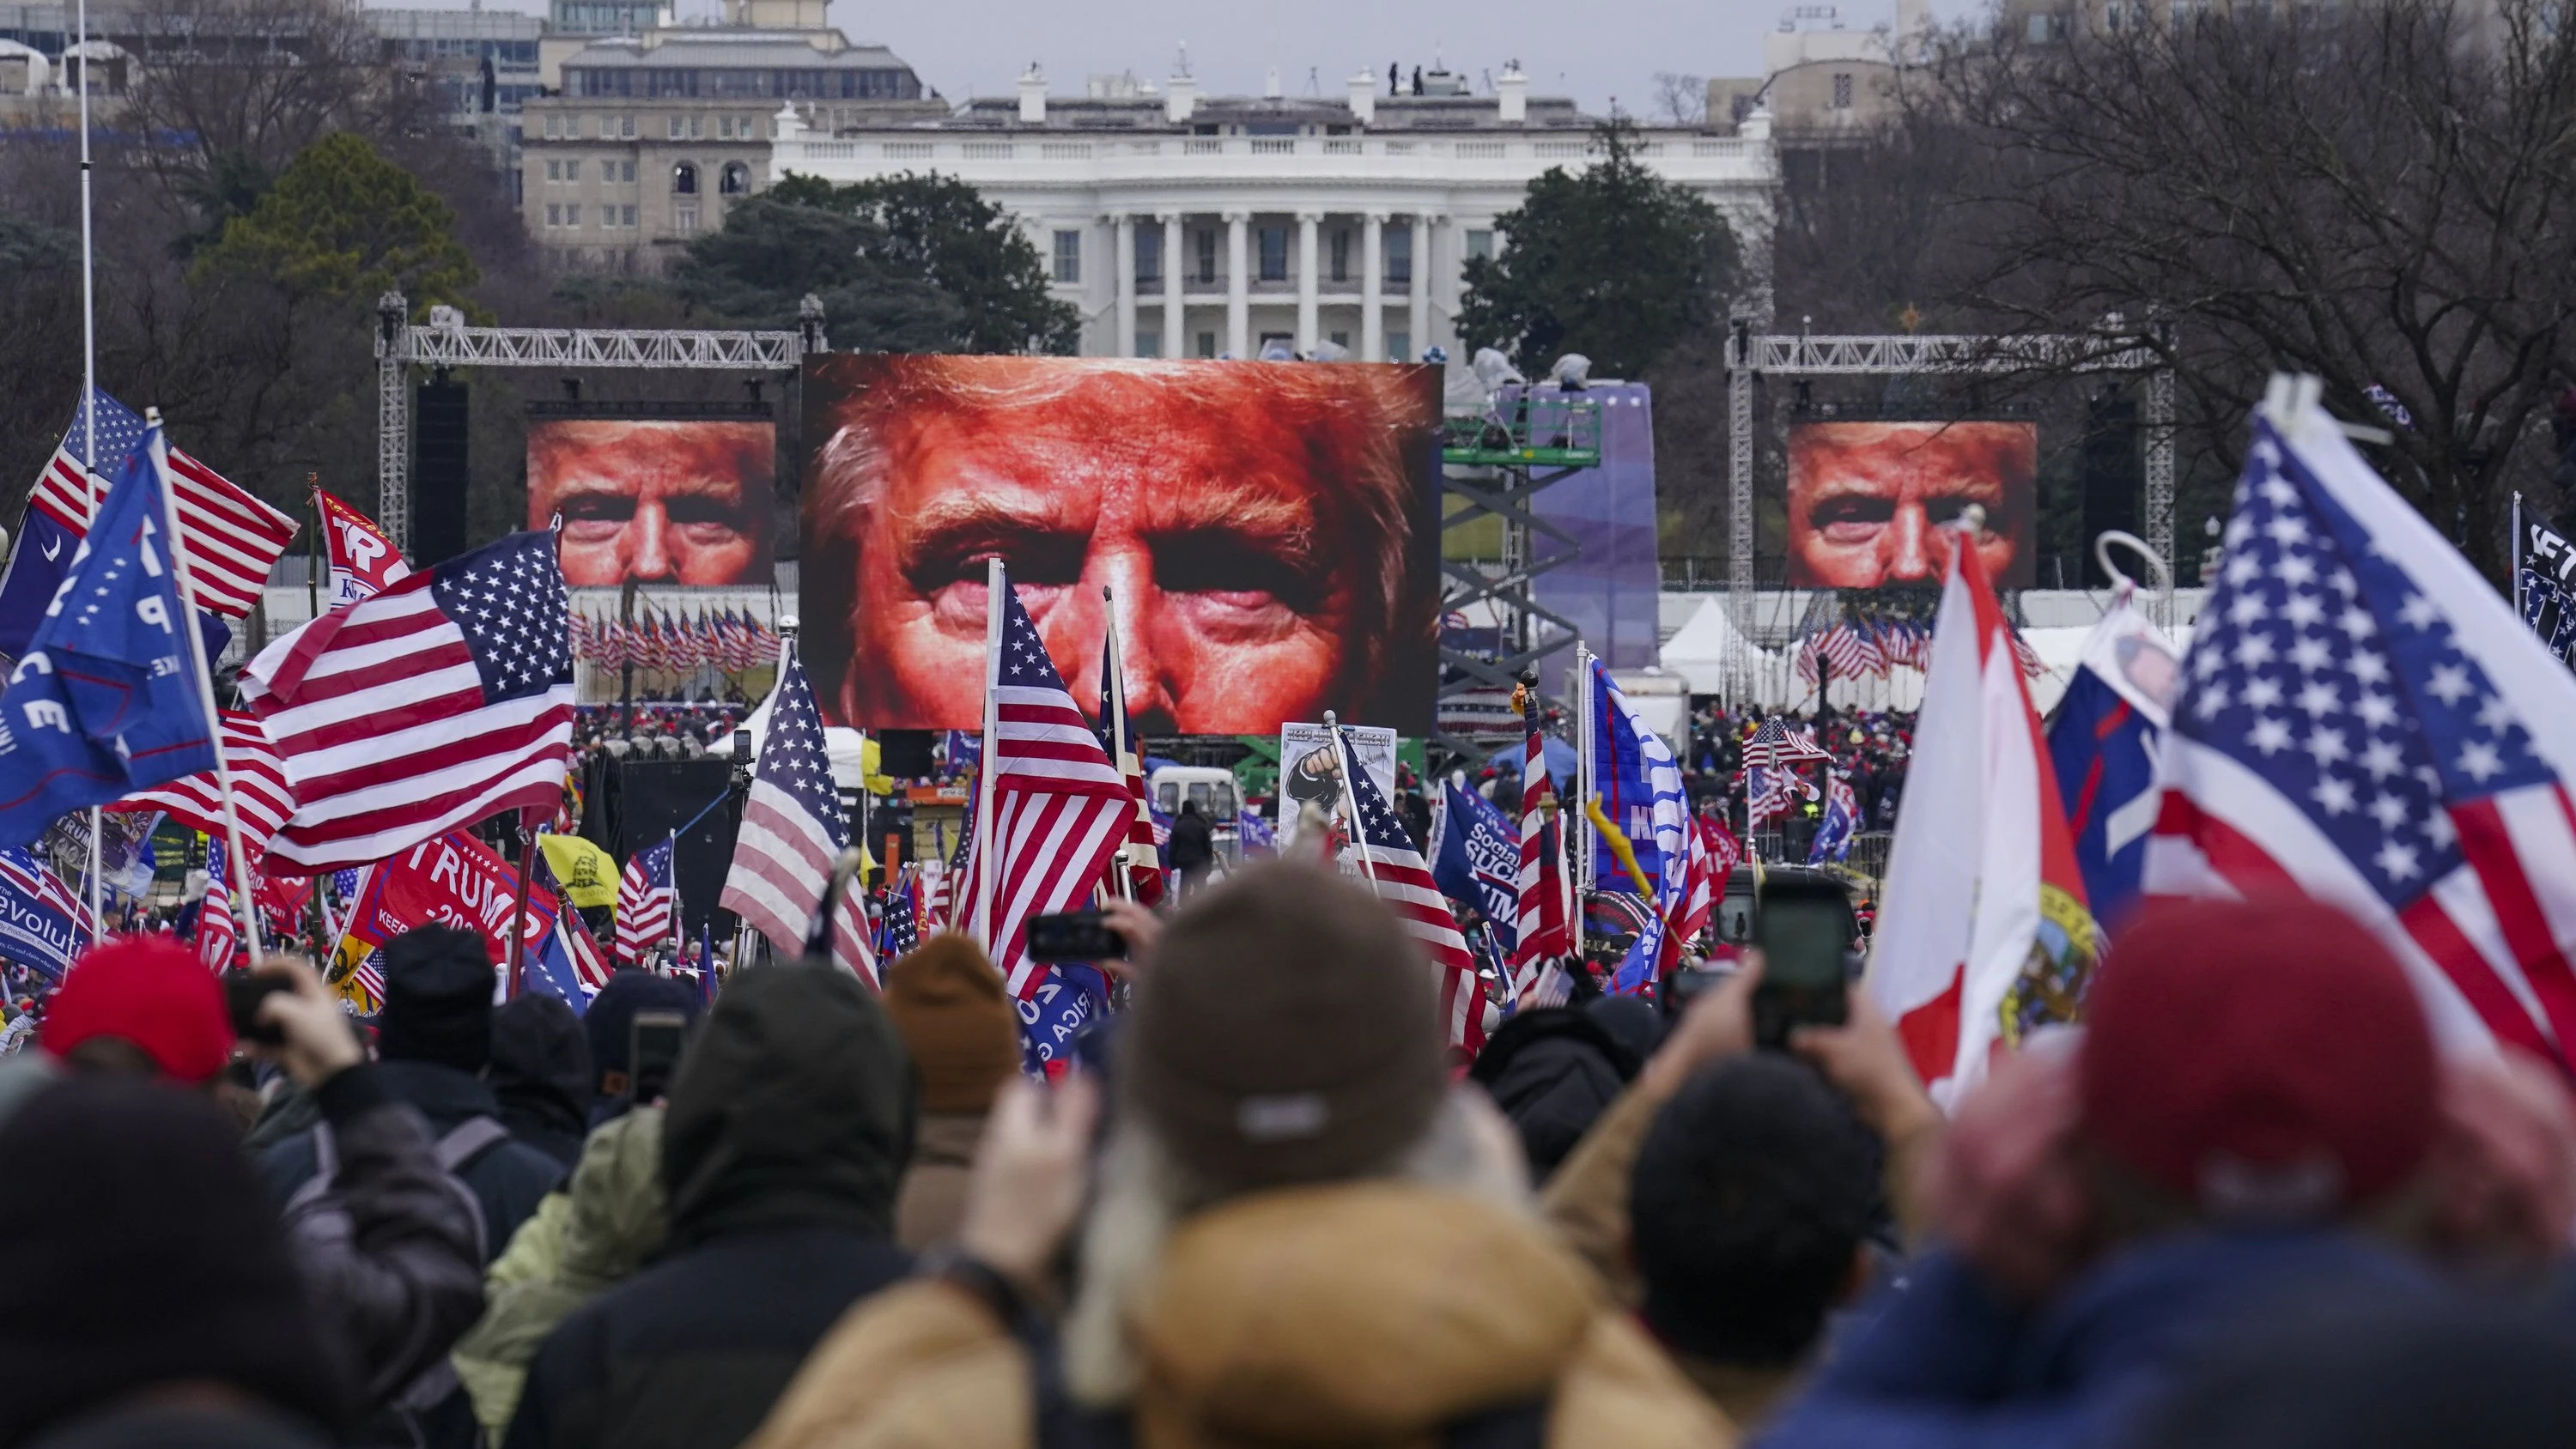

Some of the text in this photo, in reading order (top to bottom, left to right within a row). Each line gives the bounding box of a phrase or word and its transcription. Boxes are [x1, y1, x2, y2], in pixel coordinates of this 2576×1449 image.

[56, 815, 92, 848] TRUM
[1470, 822, 1521, 870] Social
[409, 838, 541, 941] TRUMP
